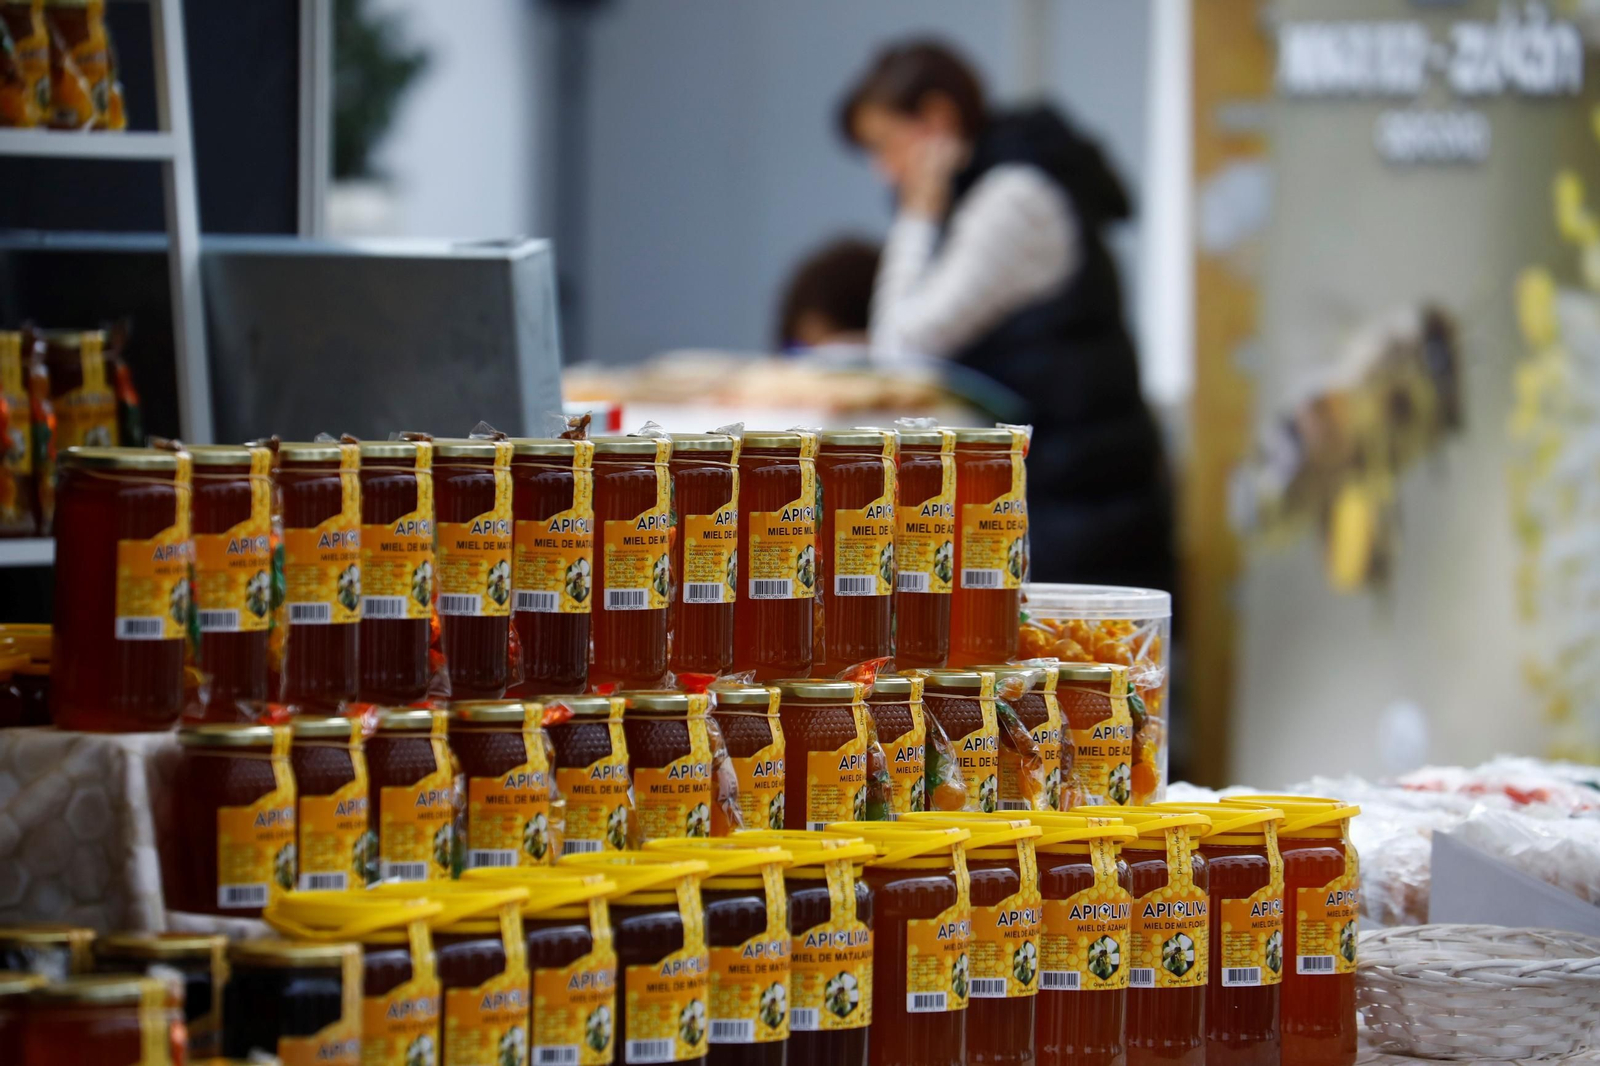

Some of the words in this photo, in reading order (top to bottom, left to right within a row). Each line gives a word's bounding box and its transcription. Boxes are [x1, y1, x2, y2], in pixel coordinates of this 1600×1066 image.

[906, 523, 930, 533] MIEL
[935, 524, 945, 533] DE
[979, 521, 1003, 530] MIEL
[1007, 521, 1016, 530] DE
[703, 531, 723, 539] MIEL
[768, 527, 790, 535] MIEL
[793, 527, 802, 535] DE
[852, 526, 876, 535] MIEL
[879, 526, 888, 535] DE
[534, 539, 558, 548] MIEL
[562, 540, 573, 548] DE
[624, 536, 646, 545] MIEL
[649, 536, 659, 544] DE
[381, 543, 404, 551] MIEL
[407, 543, 417, 551] DE
[456, 541, 480, 549] MIEL
[484, 541, 495, 550] DE
[1045, 750, 1054, 760] DE
[1078, 746, 1105, 756] MIEL
[1108, 746, 1119, 756] DE
[979, 757, 990, 767] DE
[896, 766, 911, 774] MIEL
[840, 775, 854, 783] MIEL
[855, 774, 862, 782] DE
[651, 785, 674, 793] MIEL
[678, 785, 689, 793] DE
[754, 780, 769, 789] MIEL
[771, 780, 778, 788] DE
[573, 785, 596, 794] MIEL
[600, 785, 610, 793] DE
[486, 795, 510, 804] MIEL
[514, 795, 526, 804] DE
[1143, 901, 1206, 920] APIOLIVA
[1327, 911, 1341, 919] MIEL
[1077, 924, 1095, 932] MIEL
[1144, 921, 1163, 930] MIEL
[1165, 921, 1175, 930] DE
[1177, 921, 1187, 929] MIL
[1252, 921, 1267, 929] MIEL
[1004, 930, 1019, 939] MIEL
[1021, 930, 1029, 938] DE
[805, 931, 868, 950] APIOLIVA
[792, 953, 814, 962] MIEL
[819, 953, 831, 962] DE
[729, 966, 751, 975] MIEL
[755, 965, 766, 974] DE
[647, 981, 669, 992] MIEL
[673, 981, 685, 990] DE
